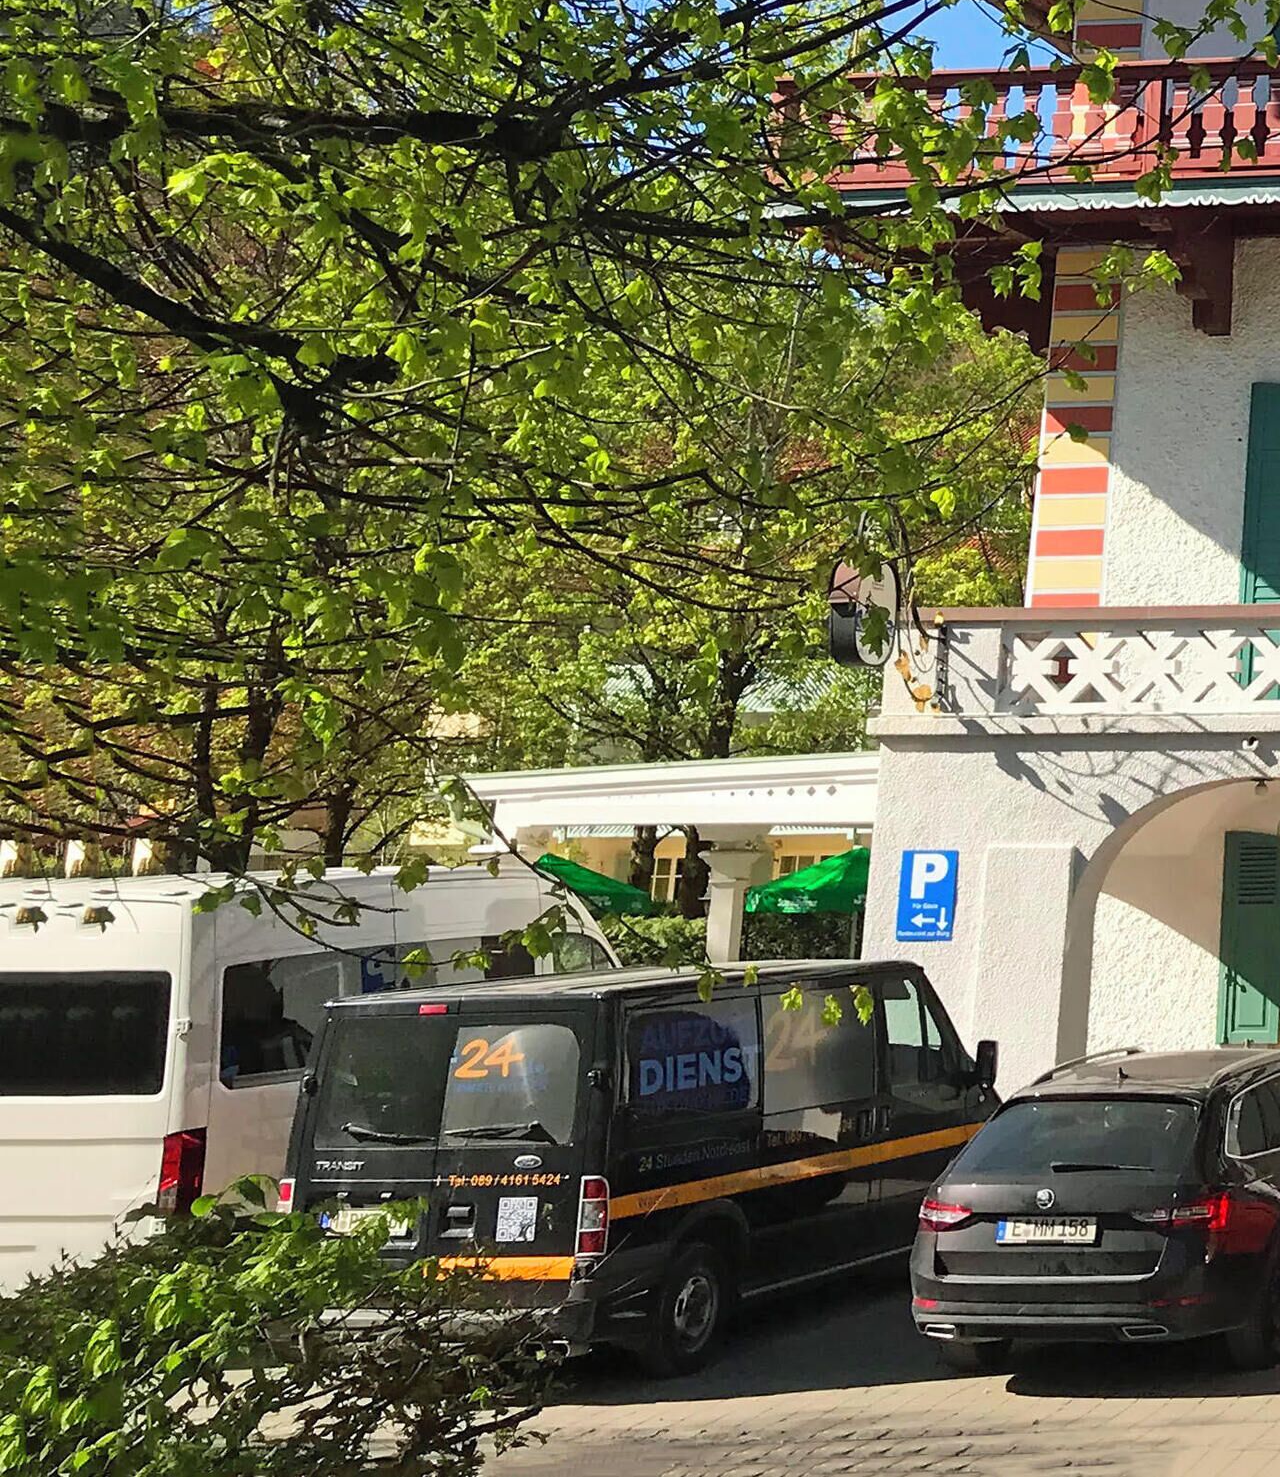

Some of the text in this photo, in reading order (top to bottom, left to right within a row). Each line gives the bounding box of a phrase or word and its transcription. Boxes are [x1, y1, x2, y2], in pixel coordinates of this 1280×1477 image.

[910, 854, 949, 899] P
[454, 1038, 525, 1079] 24
[639, 1044, 761, 1096] DIENST
[315, 1160, 365, 1172] TRANSIT
[471, 1175, 492, 1186] 089
[500, 1174, 529, 1186] 4161
[532, 1174, 561, 1185] 5424
[1012, 1219, 1089, 1237] E MM 158
